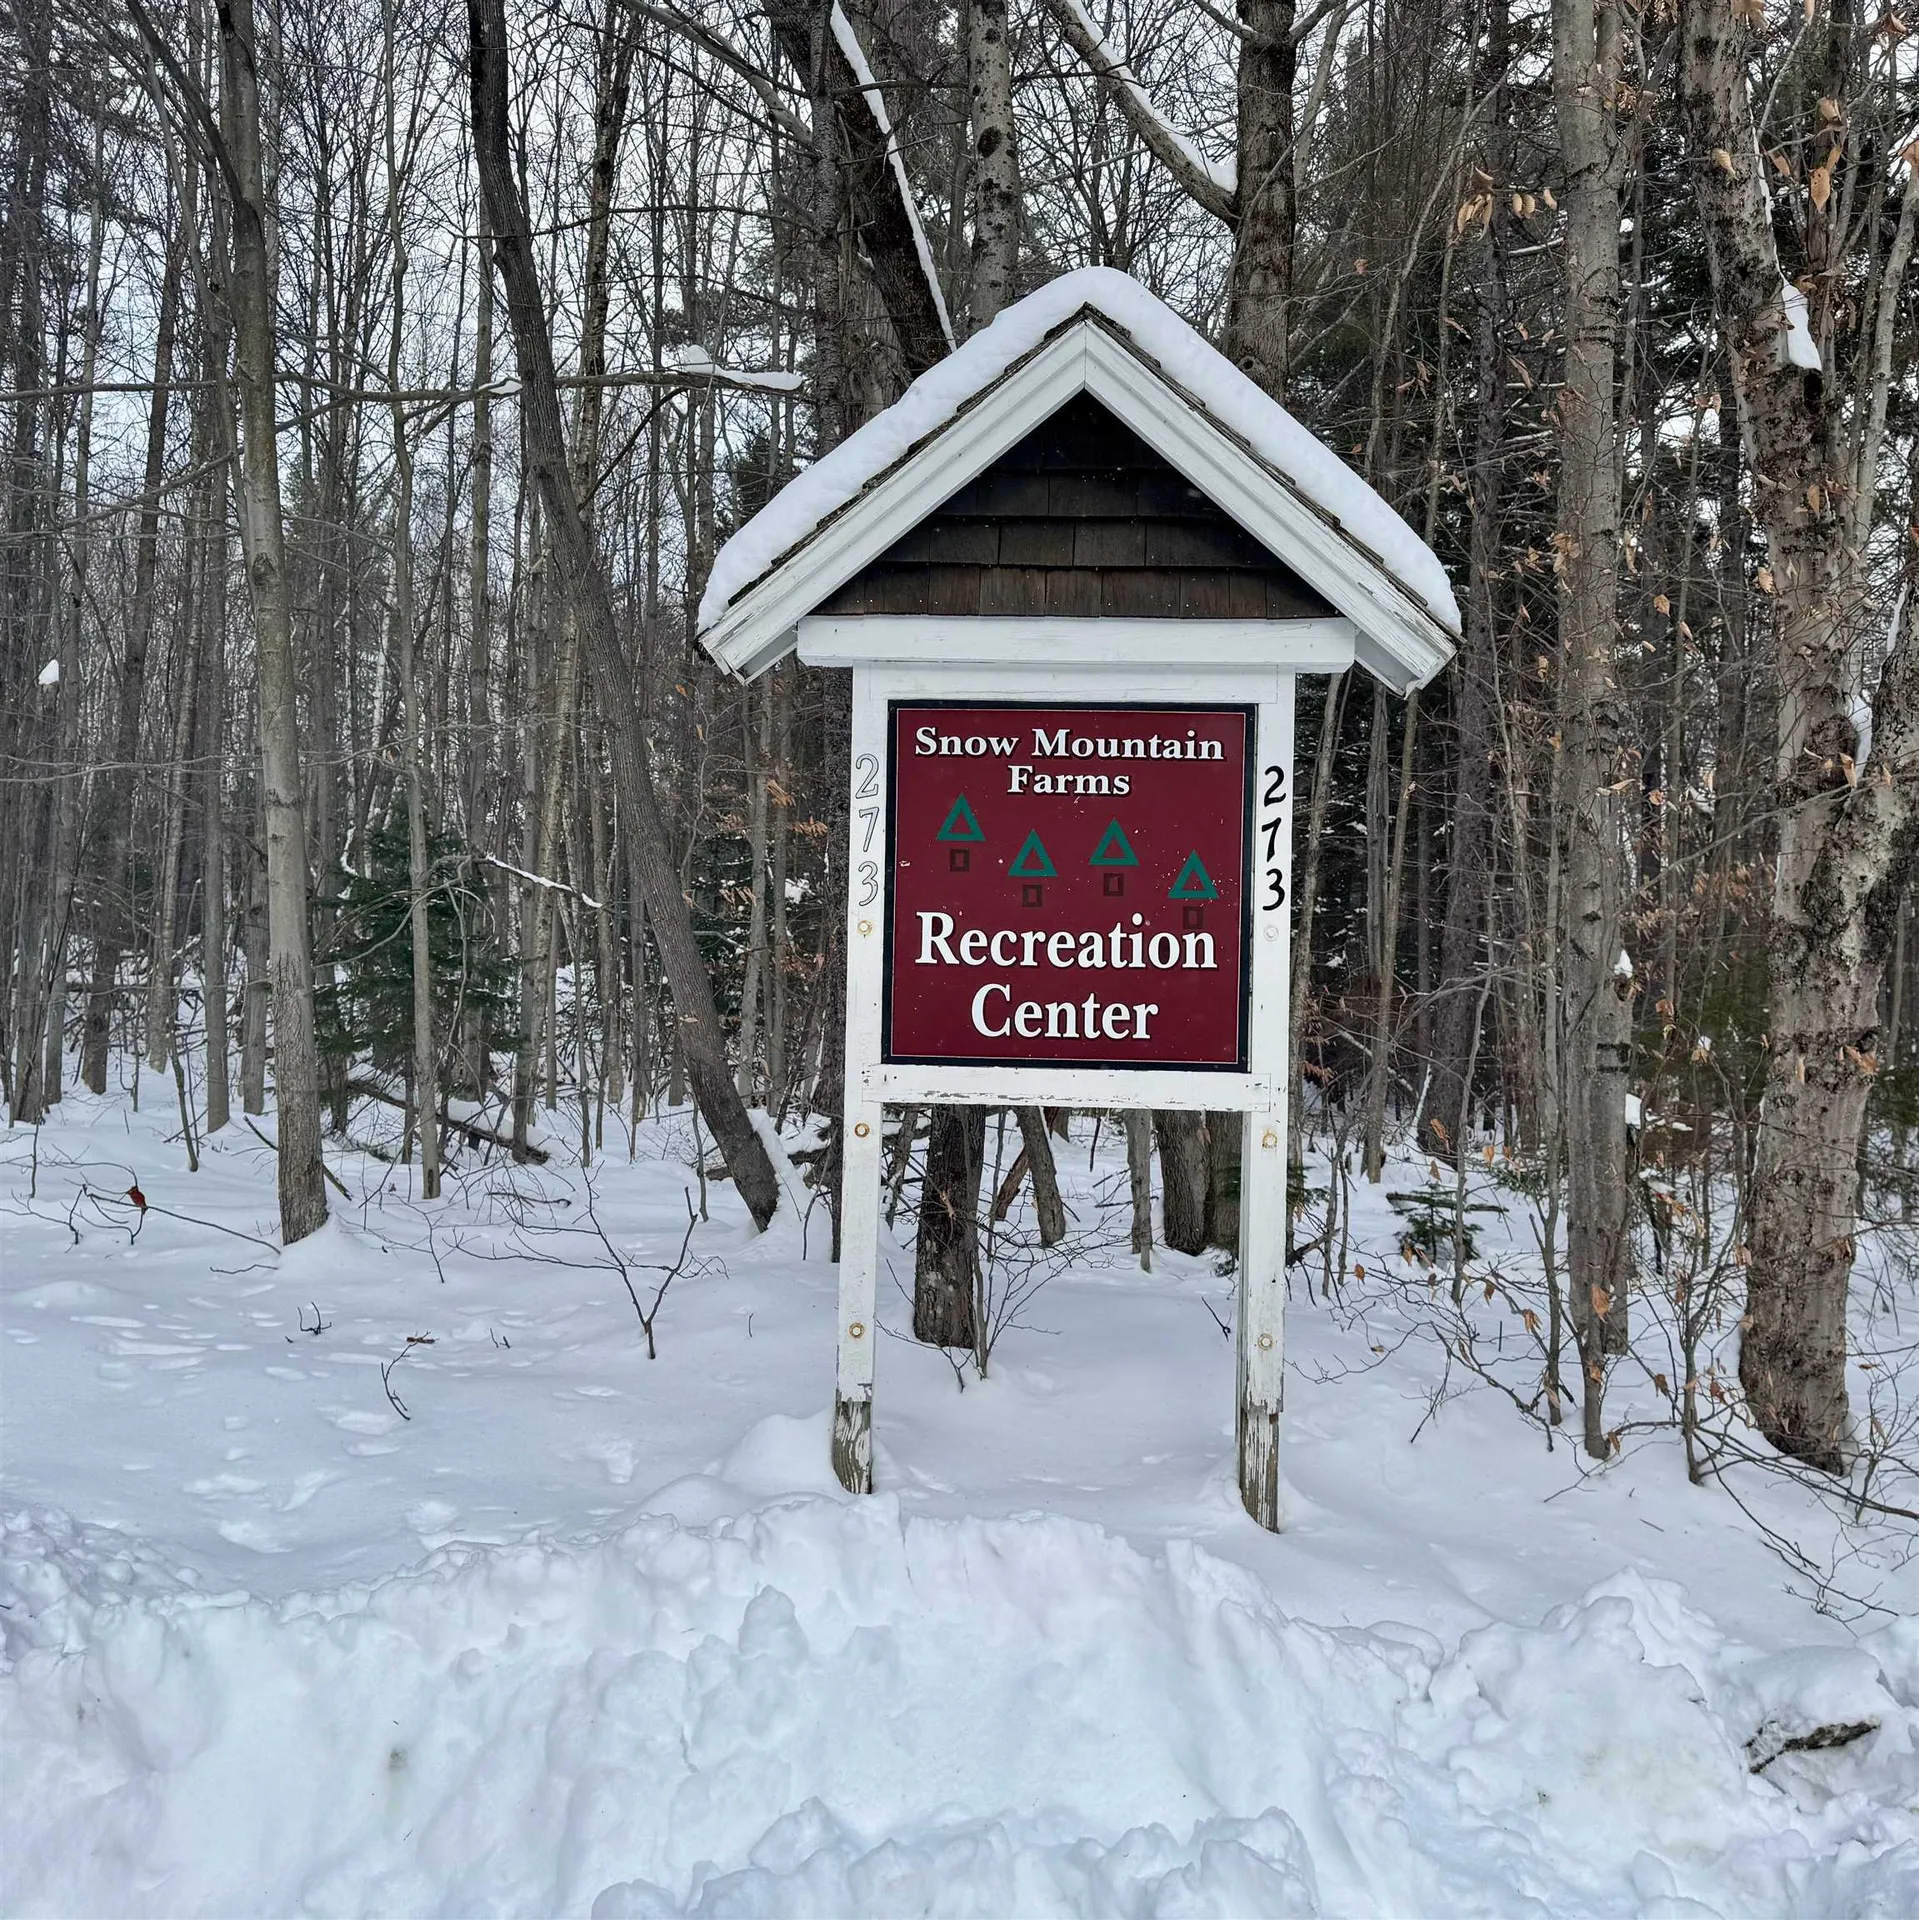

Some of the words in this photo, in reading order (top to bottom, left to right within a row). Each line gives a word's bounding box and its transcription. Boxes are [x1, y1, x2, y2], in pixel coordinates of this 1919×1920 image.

[915, 726, 1018, 757] Snow
[1031, 728, 1225, 760] Mountain
[1007, 764, 1131, 796] Farms
[855, 753, 880, 907] 273
[1260, 765, 1287, 912] 273
[914, 911, 1218, 969] Recreation
[971, 983, 1158, 1039] Center
